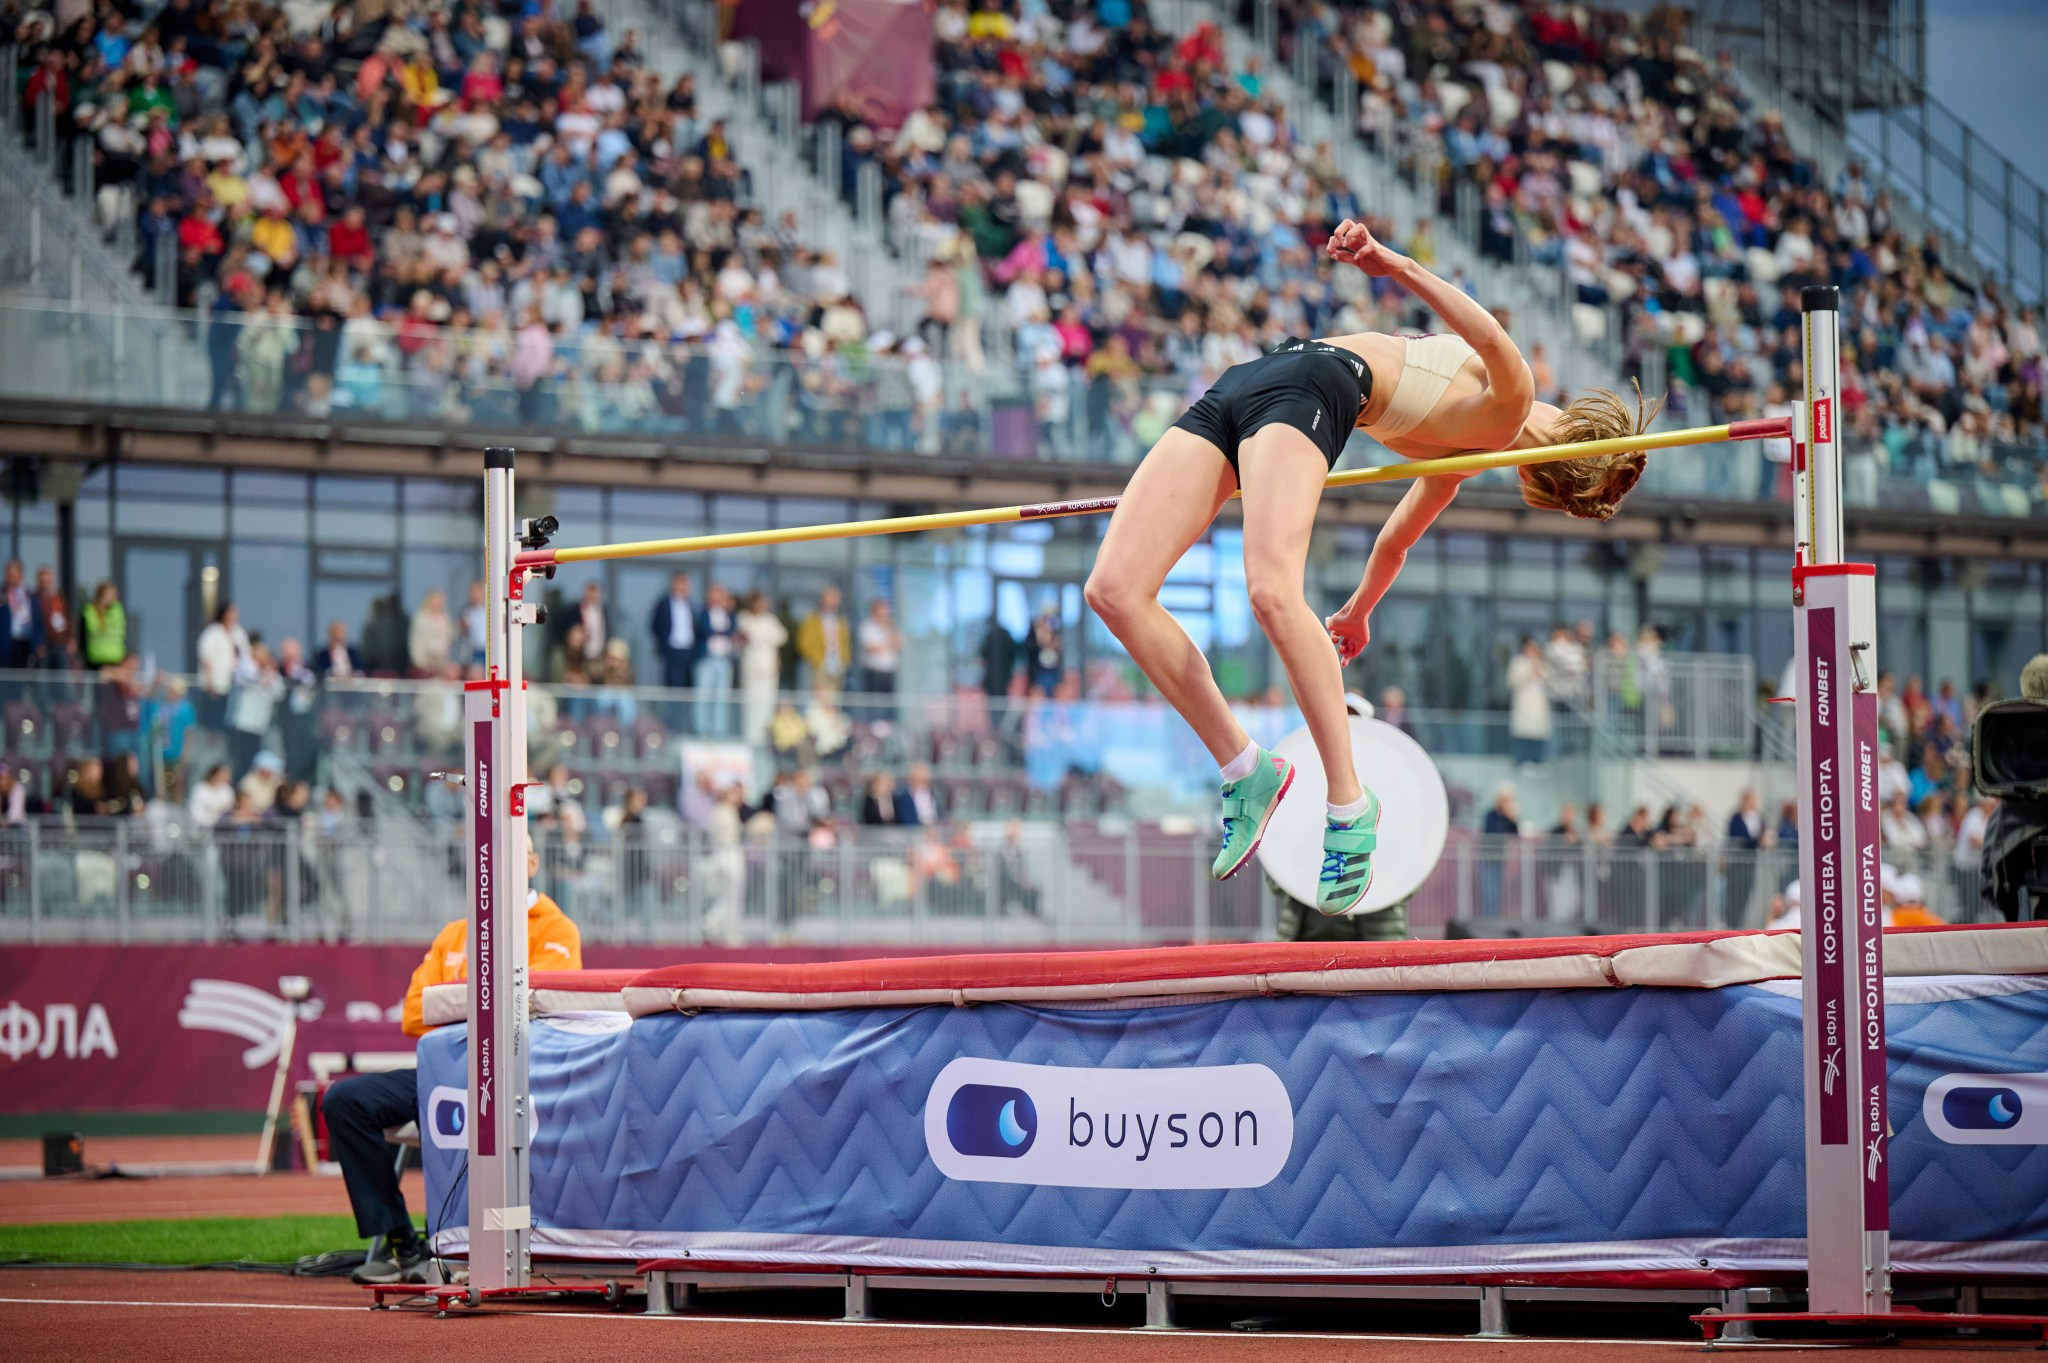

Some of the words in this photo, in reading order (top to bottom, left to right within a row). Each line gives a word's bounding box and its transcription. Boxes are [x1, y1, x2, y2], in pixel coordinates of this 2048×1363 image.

[1817, 403, 1829, 440] polanik
[1817, 656, 1830, 727] FONBET
[479, 760, 488, 818] FONBET
[1820, 758, 1834, 841] СПОРТА
[1860, 741, 1872, 812] FONBET
[480, 843, 489, 911] СПОРТА
[1822, 851, 1837, 964] КОРОЛЕВА
[1862, 843, 1876, 927] СПОРТА
[480, 918, 490, 1010] КОРОЛЕВА
[1865, 937, 1880, 1050] КОРОЛЕВА
[482, 1037, 490, 1076] ВФЛА
[1827, 999, 1838, 1046] ВФЛА
[1069, 1097, 1258, 1162] buyson
[1870, 1084, 1880, 1132] ВФЛА
